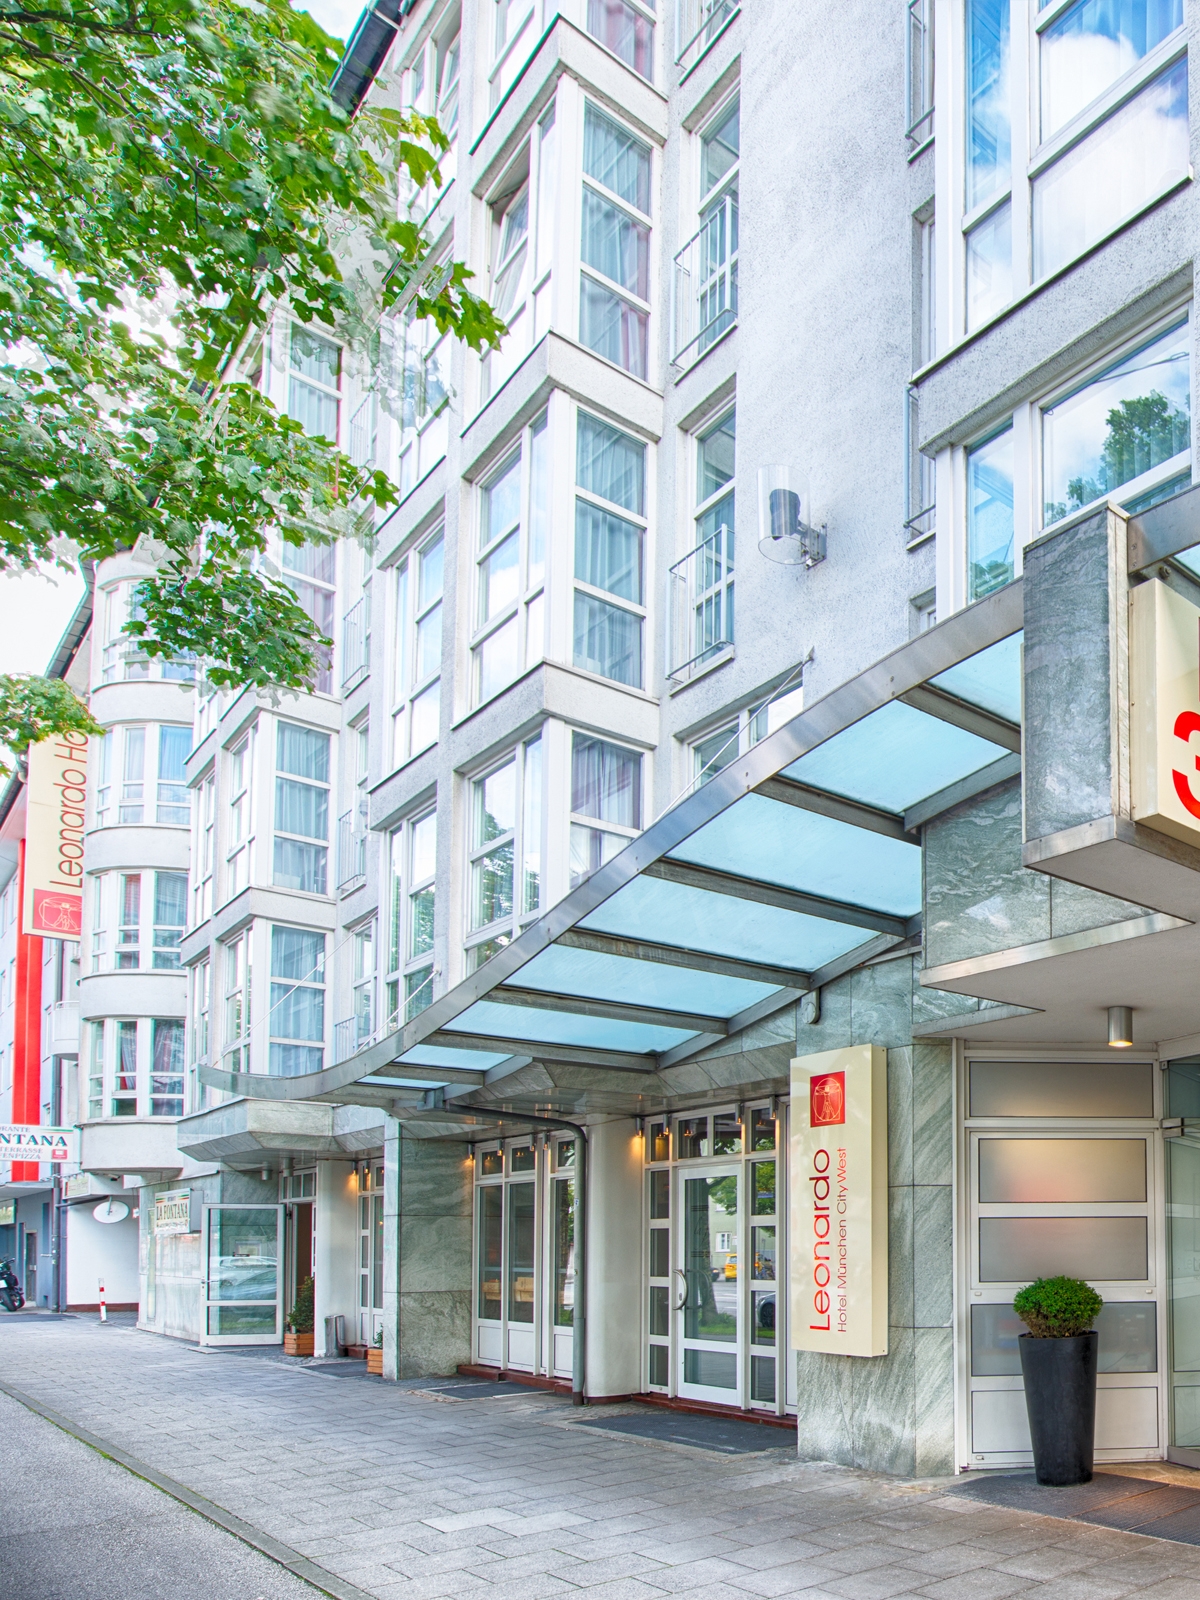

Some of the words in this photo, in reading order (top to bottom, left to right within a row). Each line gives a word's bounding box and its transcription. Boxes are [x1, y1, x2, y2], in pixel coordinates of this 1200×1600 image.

[49, 768, 87, 888] Leonardo
[156, 1205, 163, 1221] LA
[163, 1202, 188, 1220] FONTANA
[809, 1149, 830, 1331] Leonardo
[837, 1219, 847, 1289] München
[837, 1294, 847, 1333] Hotel
